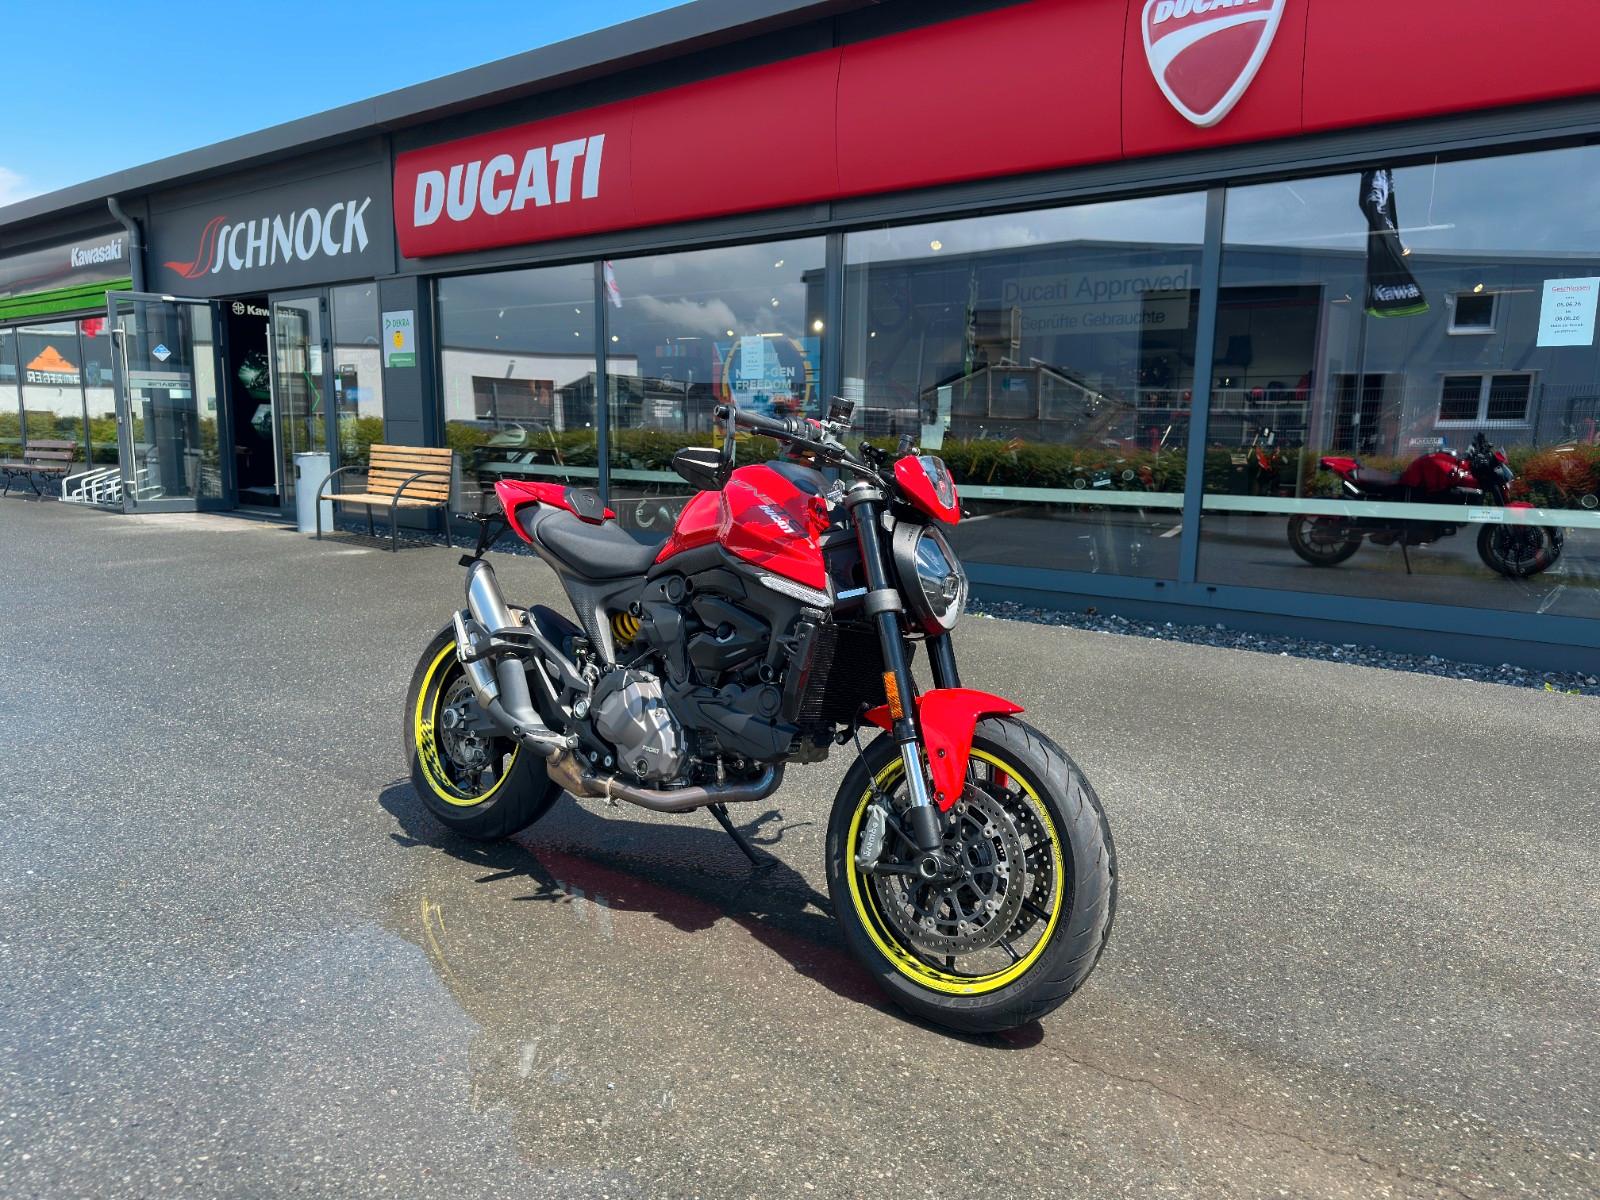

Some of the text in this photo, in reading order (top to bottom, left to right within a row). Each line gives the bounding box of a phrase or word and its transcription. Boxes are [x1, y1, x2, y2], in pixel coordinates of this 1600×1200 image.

[413, 134, 605, 227] DUCATI
[211, 196, 371, 274] SCHNOCK
[71, 239, 122, 267] Kawasaki
[1005, 269, 1188, 301] Ducati Approved
[1082, 309, 1166, 327] Gebrauchte
[736, 379, 791, 390] FREEDOM
[759, 505, 795, 533] DUCATI
